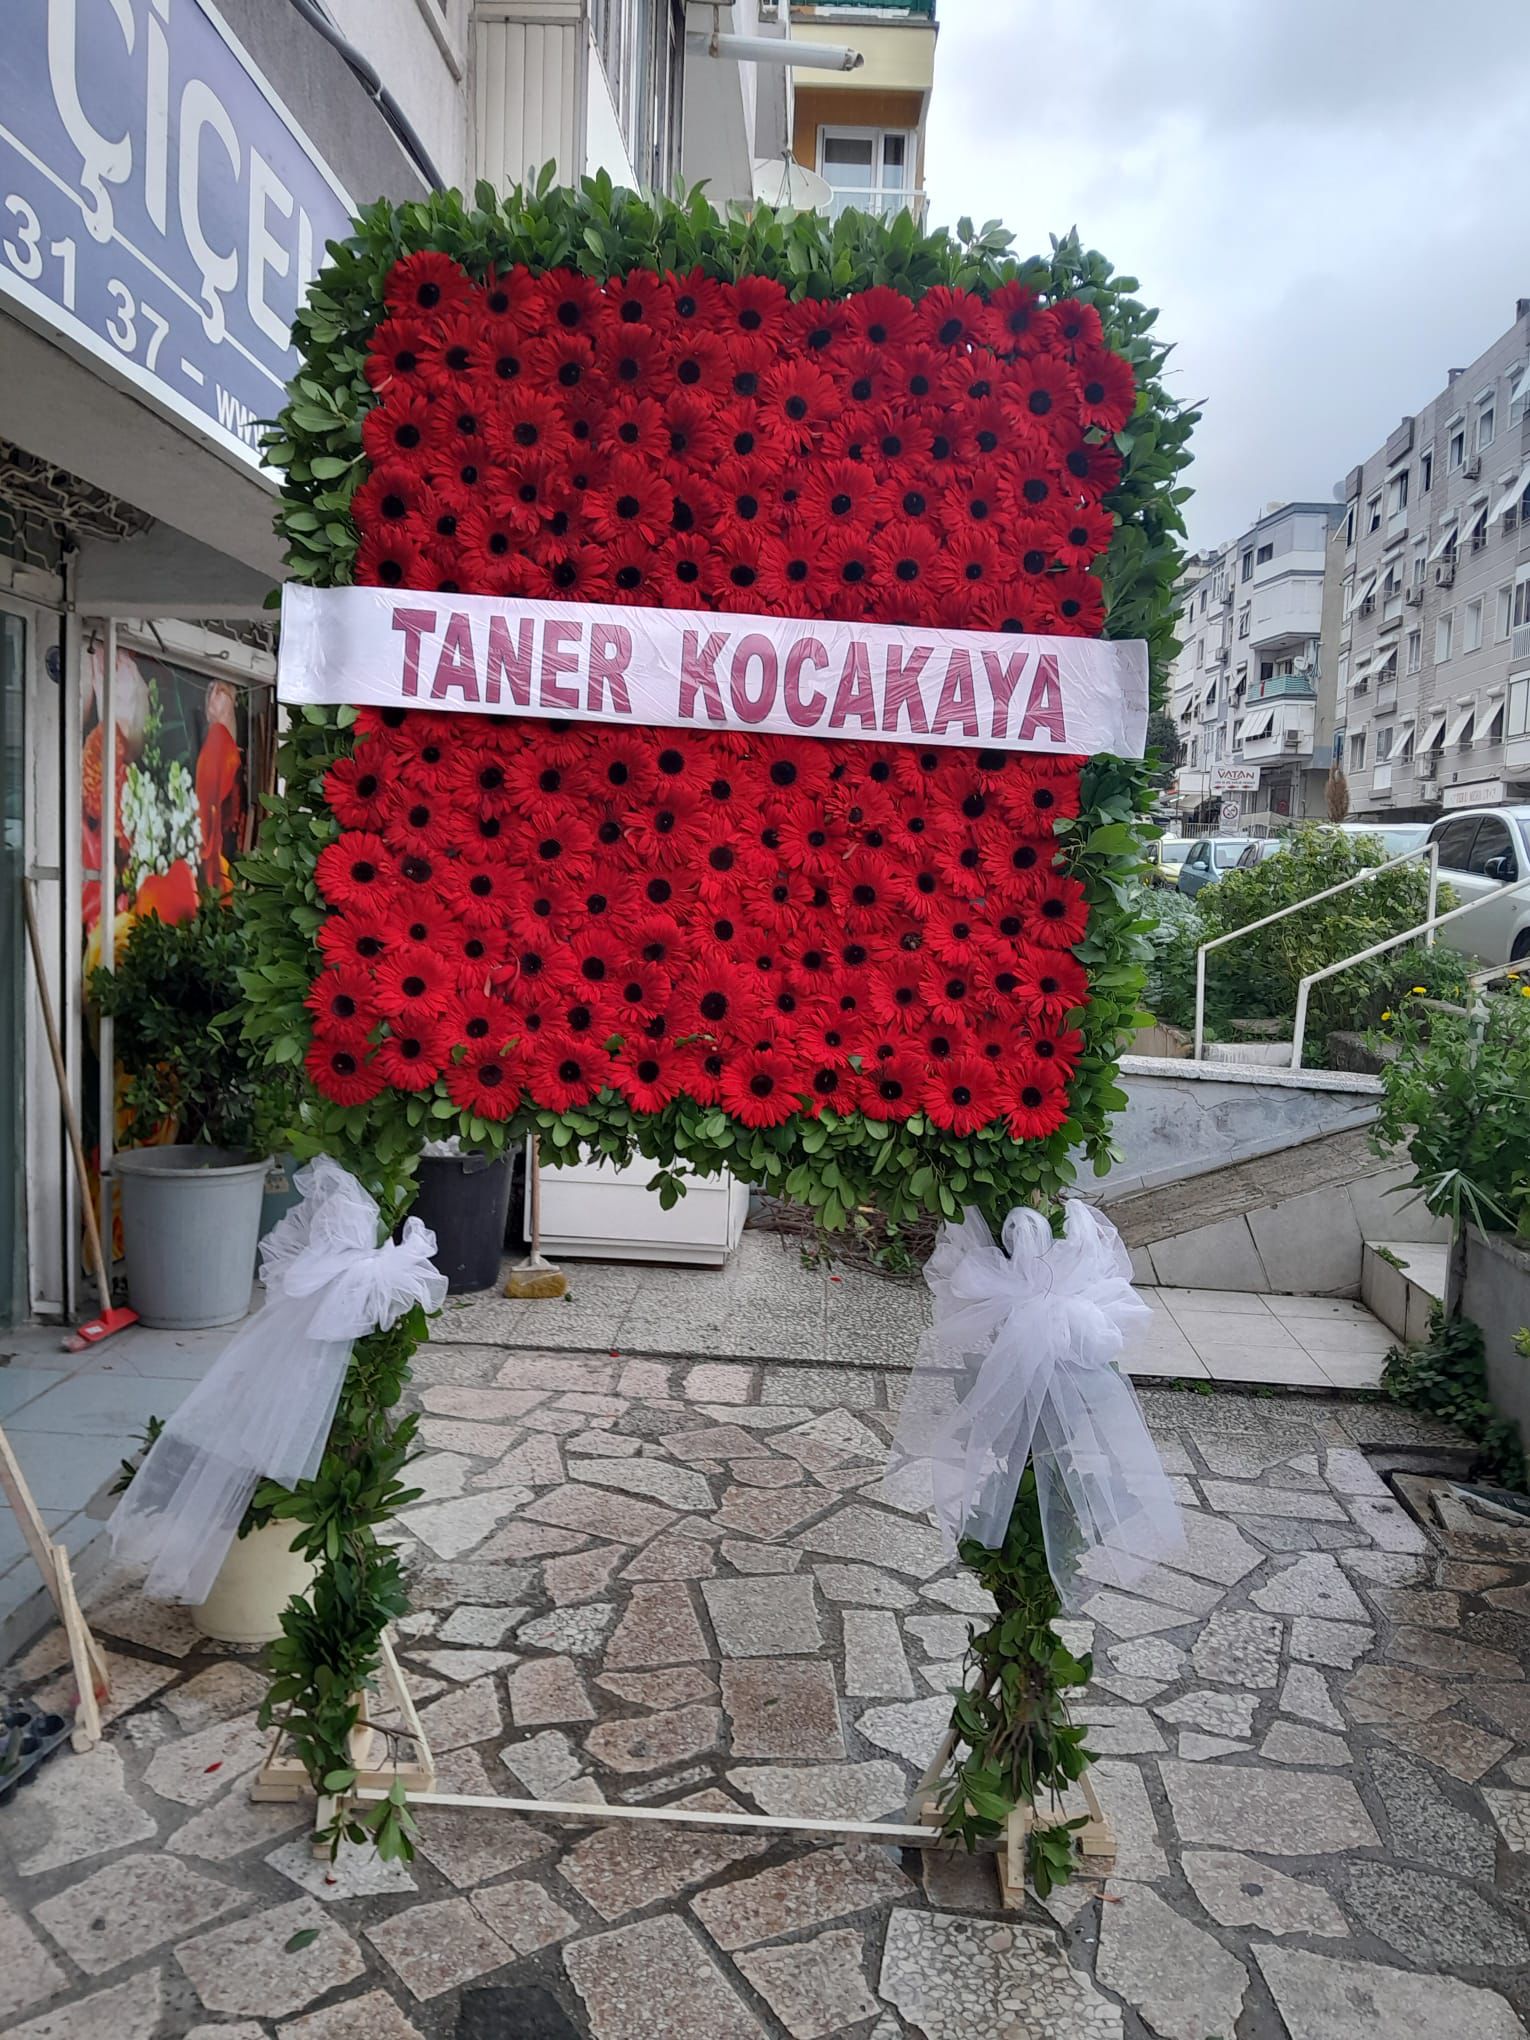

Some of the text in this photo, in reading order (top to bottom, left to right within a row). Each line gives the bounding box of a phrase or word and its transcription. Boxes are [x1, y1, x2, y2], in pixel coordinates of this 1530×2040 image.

[3, 194, 76, 312] 31
[106, 278, 170, 372] 37
[392, 608, 1067, 744] TANER KOCAKAYA
[1217, 768, 1255, 779] VATAN
